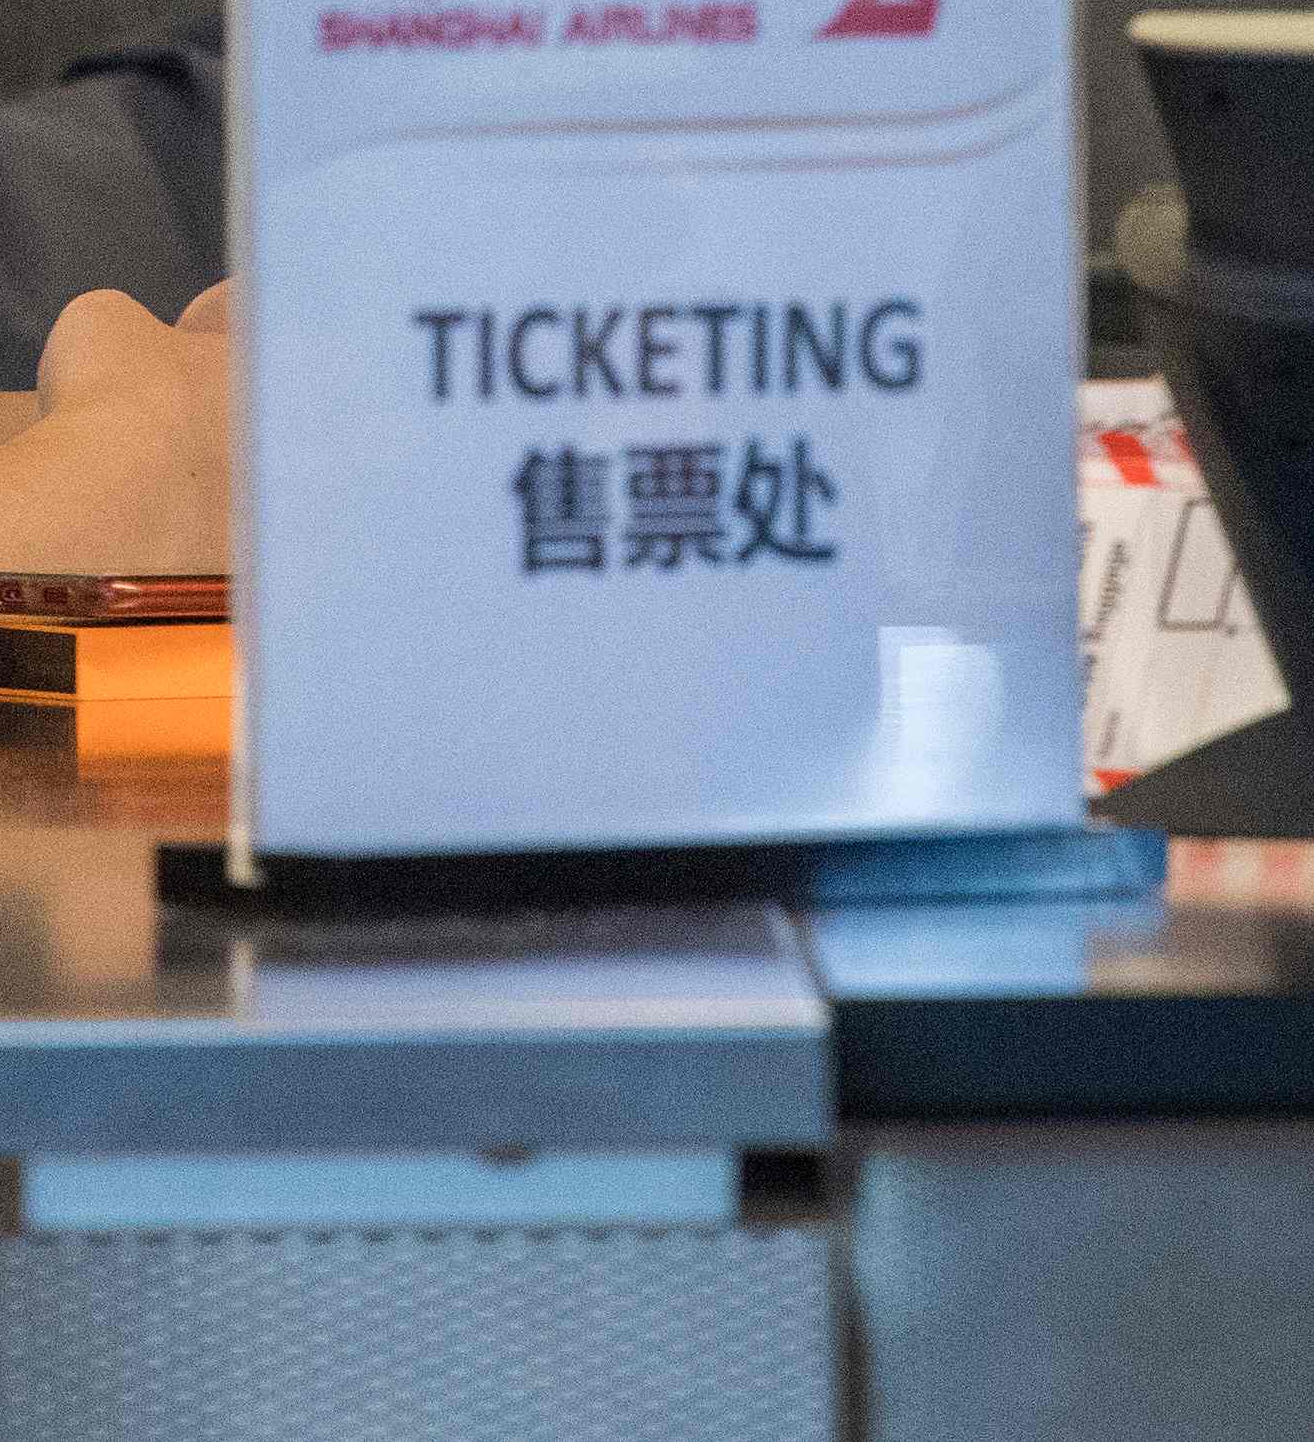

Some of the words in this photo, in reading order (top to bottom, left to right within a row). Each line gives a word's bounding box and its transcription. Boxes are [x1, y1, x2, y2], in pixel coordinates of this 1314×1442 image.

[317, 6, 544, 54] SHANGHAI
[562, 0, 760, 46] AIRLINES
[412, 296, 926, 402] TICKETING
[513, 435, 840, 573] 售票处
